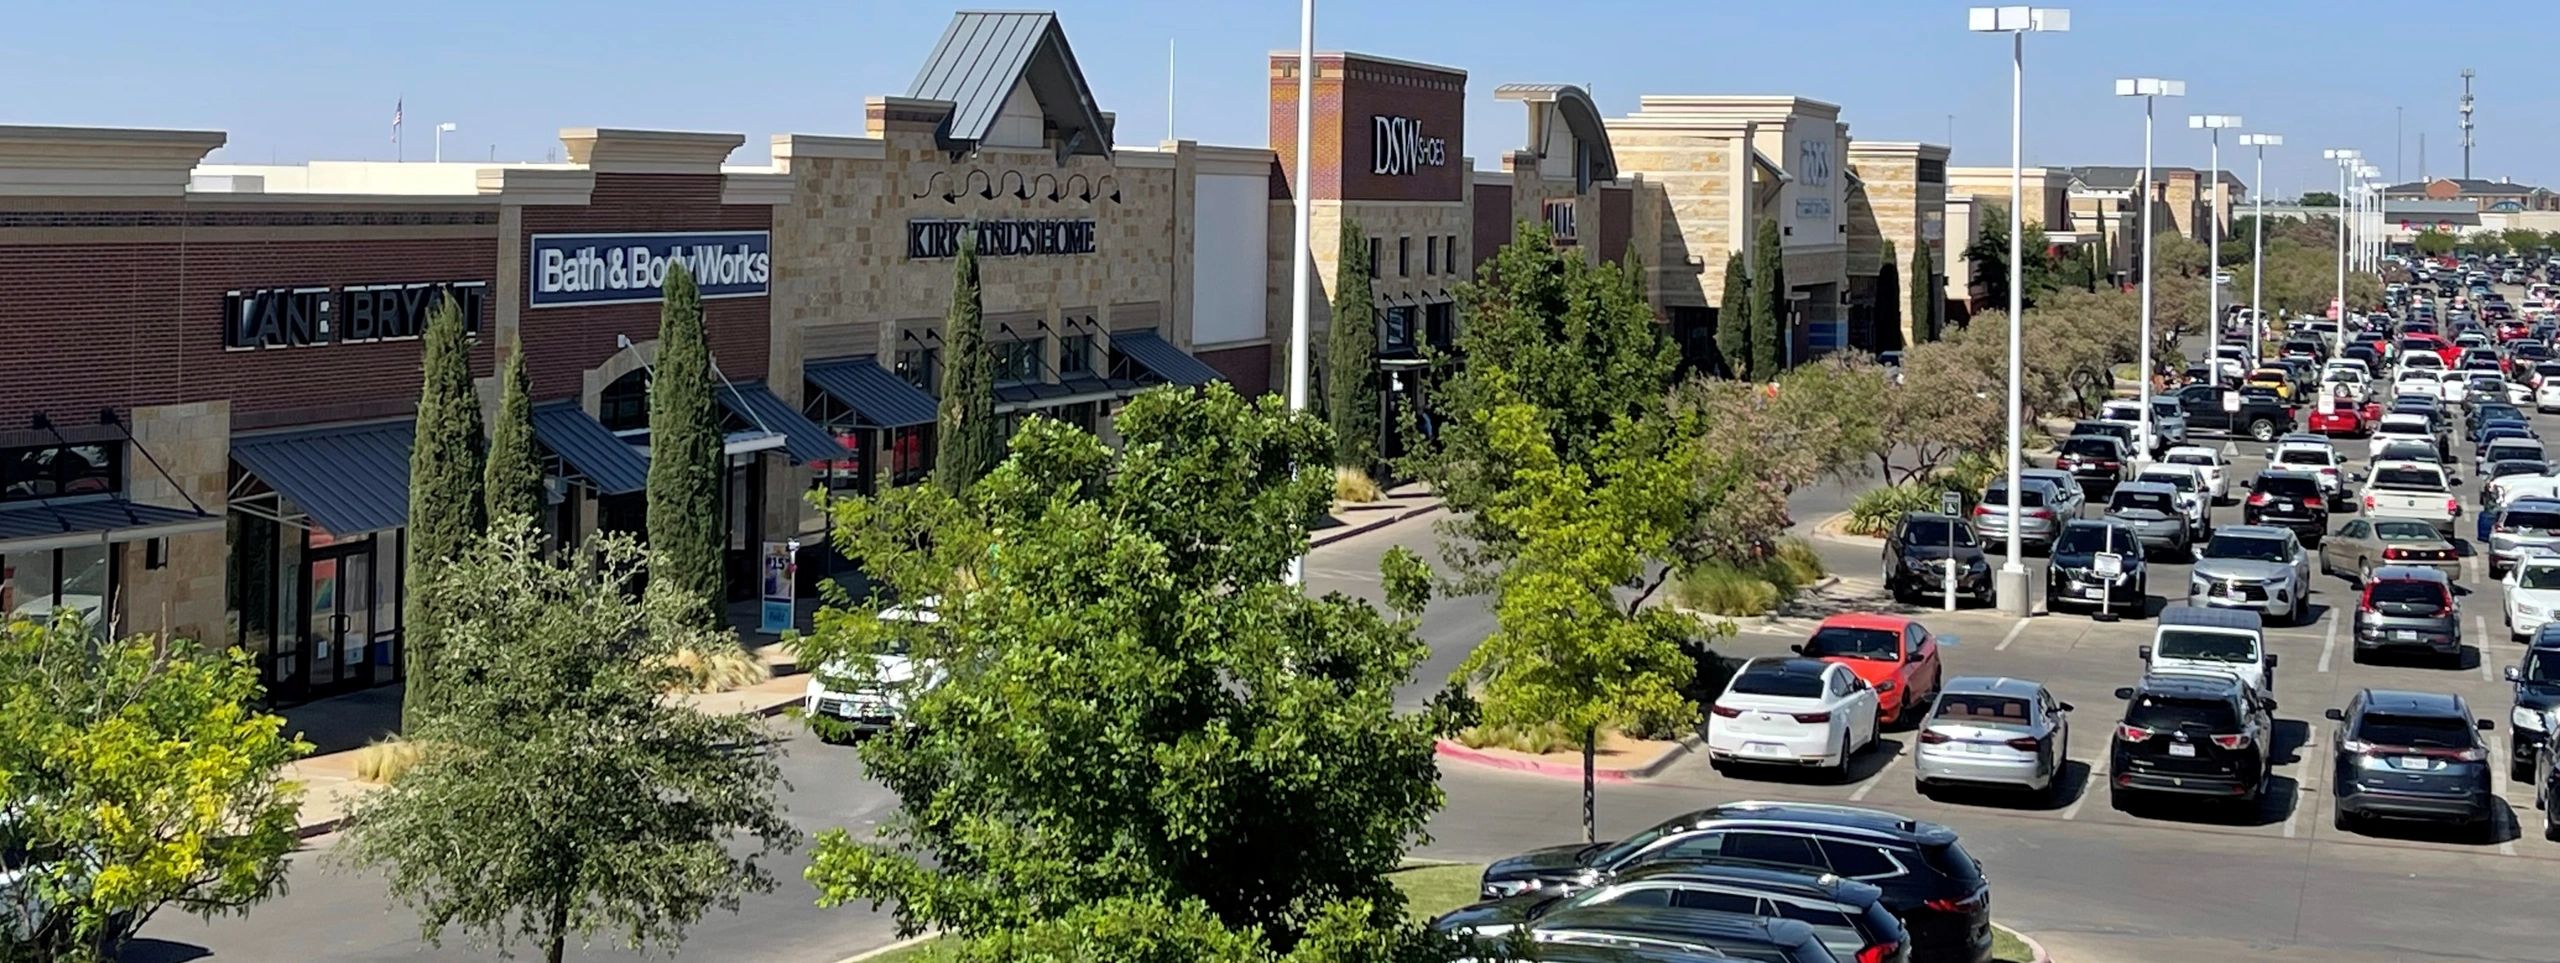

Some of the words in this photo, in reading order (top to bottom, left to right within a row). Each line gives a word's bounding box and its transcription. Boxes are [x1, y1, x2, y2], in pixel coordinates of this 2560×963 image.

[1374, 115, 1421, 175] DSW
[1418, 136, 1446, 167] SHOES
[911, 219, 1036, 258] KIRKAND'S
[1036, 219, 1096, 254] HOME
[540, 246, 605, 292] Bath
[607, 247, 629, 290] &
[693, 244, 769, 285] Works
[227, 288, 331, 350] LANE
